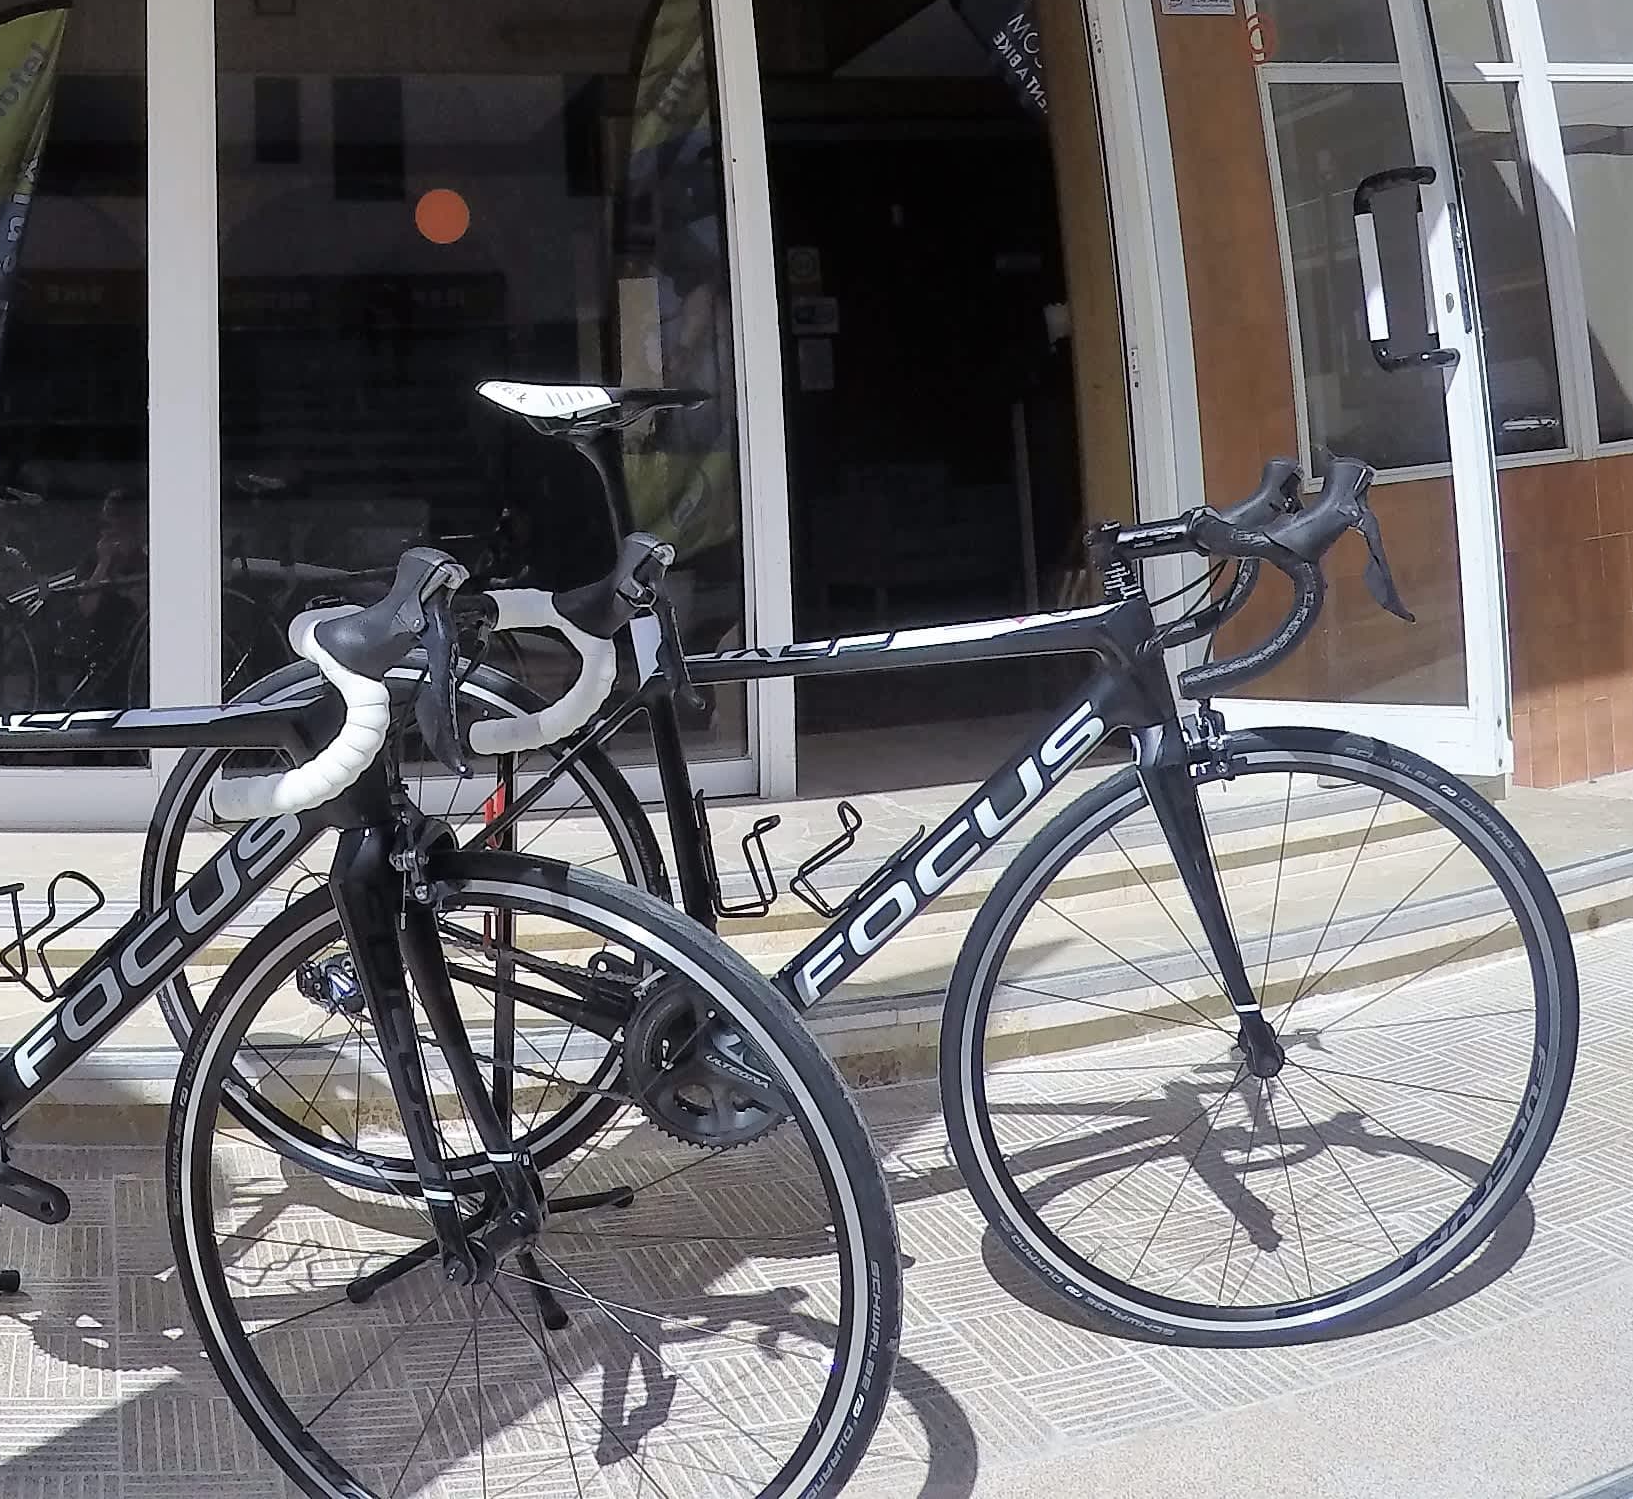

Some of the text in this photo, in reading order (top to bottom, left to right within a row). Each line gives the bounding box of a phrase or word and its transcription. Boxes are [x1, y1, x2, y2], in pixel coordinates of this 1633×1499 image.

[14, 812, 302, 1091] FOCUS
[792, 701, 1107, 1009] FOCUS
[860, 1259, 884, 1392] SCHWALBE
